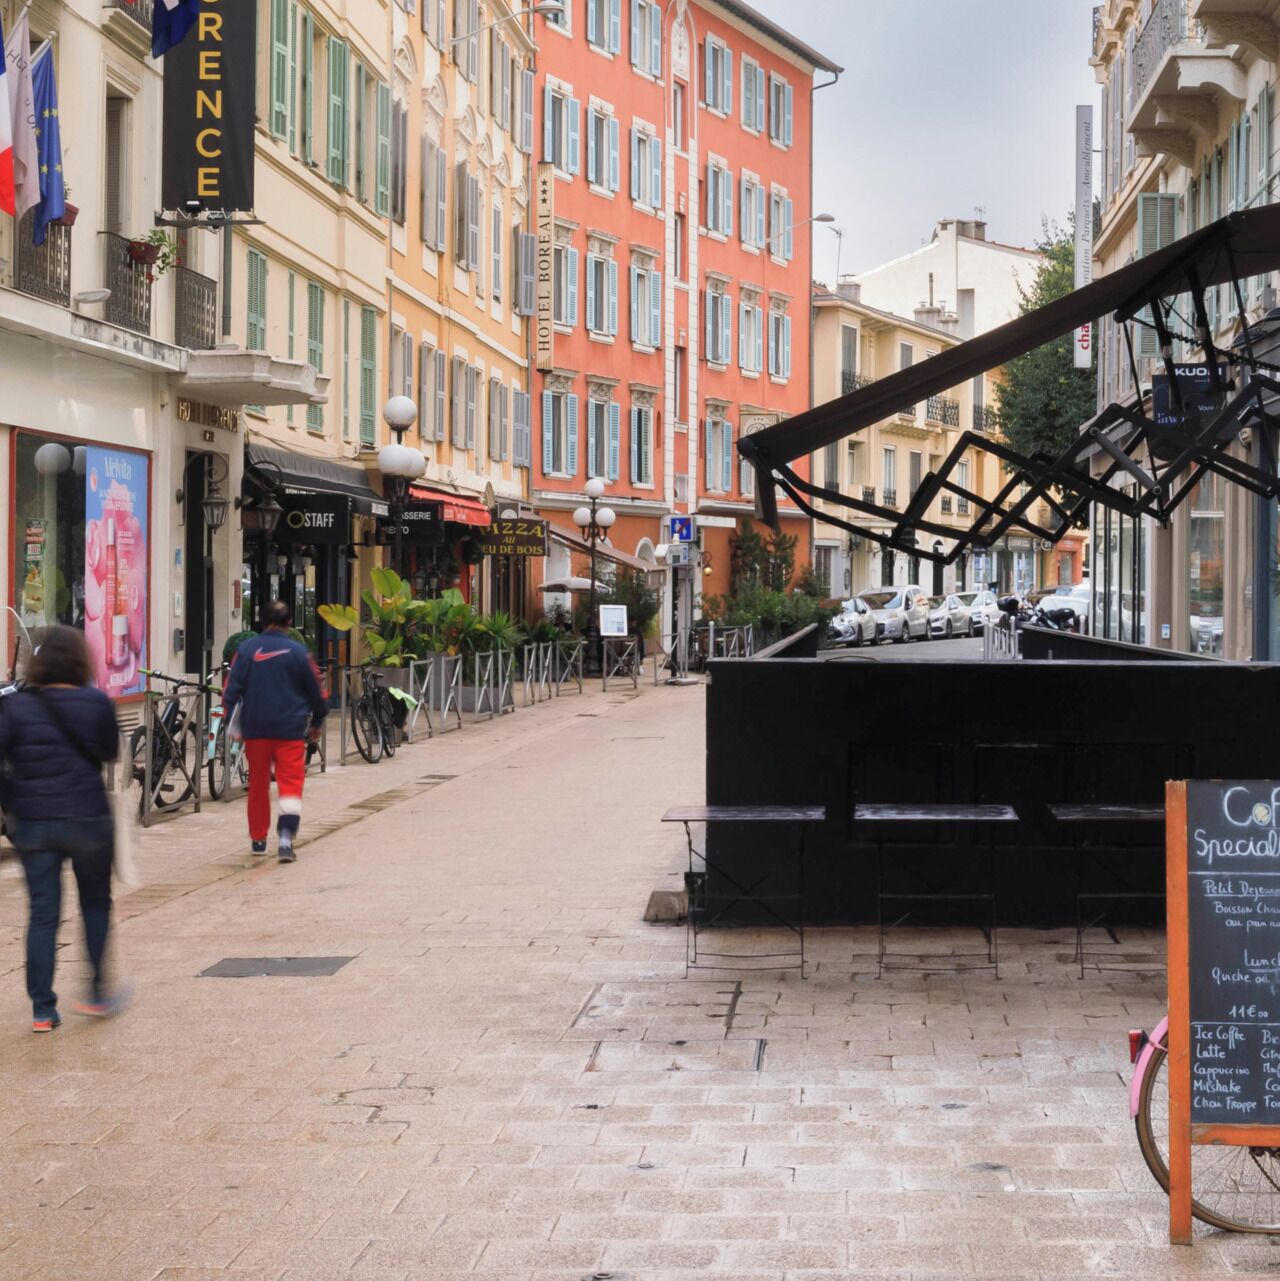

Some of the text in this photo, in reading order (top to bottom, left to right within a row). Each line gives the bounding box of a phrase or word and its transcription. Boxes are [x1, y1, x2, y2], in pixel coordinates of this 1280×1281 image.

[1082, 120, 1092, 189] Ameublement
[538, 209, 551, 352] HOTEL BOREAL
[1175, 367, 1222, 376] KUOI
[503, 536, 516, 544] AU
[500, 545, 514, 554] DE
[517, 545, 544, 554] BOIS
[1203, 879, 1233, 895] Petit
[1213, 901, 1253, 915] Boisson
[1211, 967, 1251, 984] Quiche
[1194, 1024, 1213, 1040] Ice
[1196, 1044, 1226, 1058] Latte
